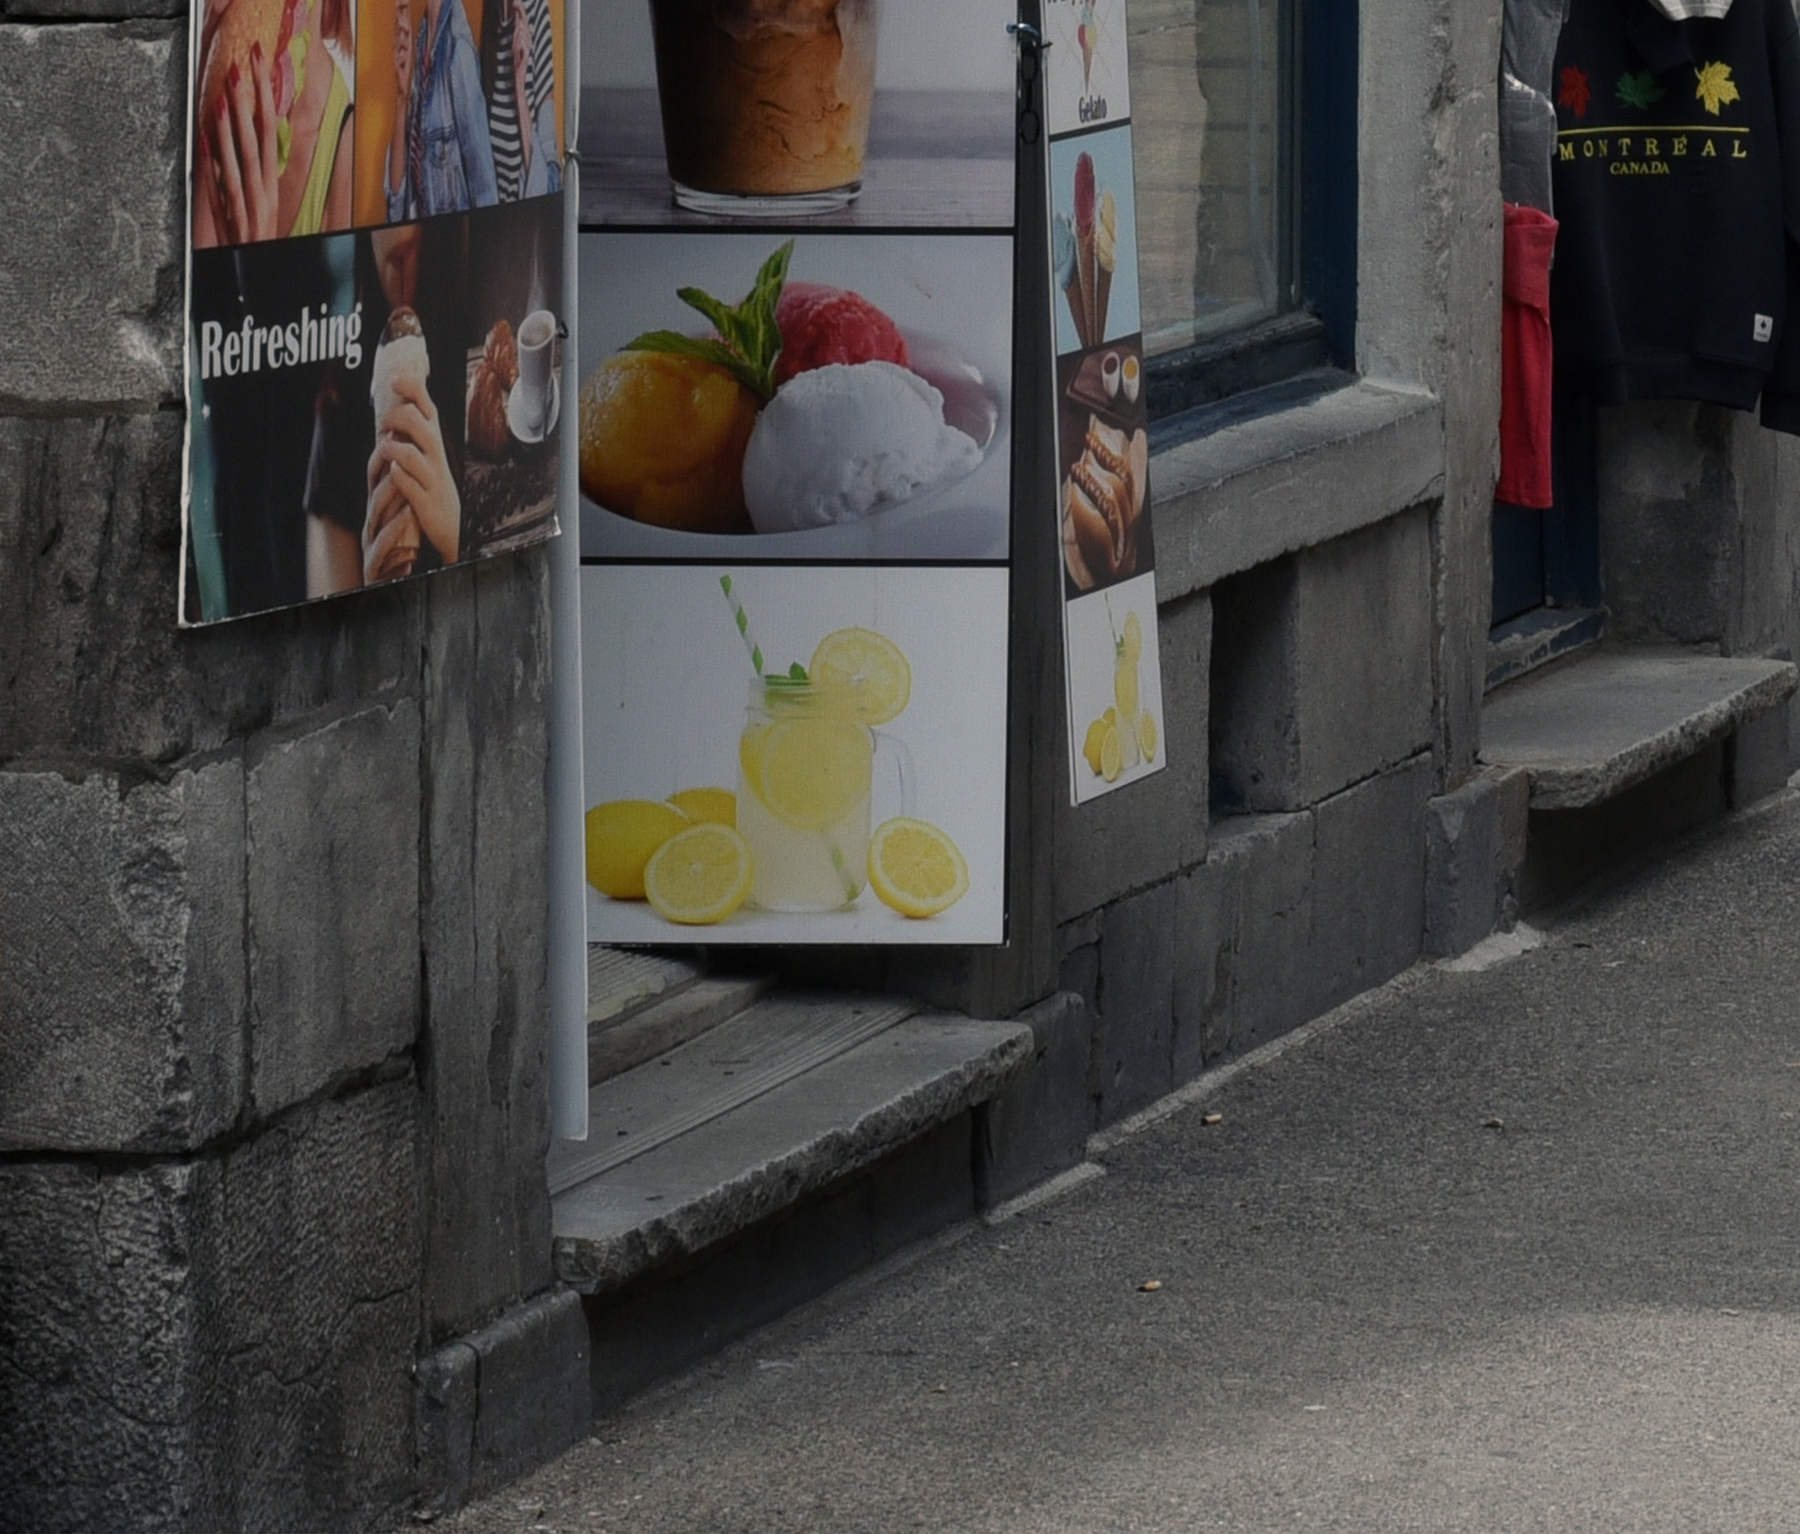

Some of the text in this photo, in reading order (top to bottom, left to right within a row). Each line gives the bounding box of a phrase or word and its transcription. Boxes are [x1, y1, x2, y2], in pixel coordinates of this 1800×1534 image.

[1559, 134, 1748, 162] MONTRÉAL
[1609, 159, 1671, 177] CANADA
[201, 301, 363, 381] Refreshing
